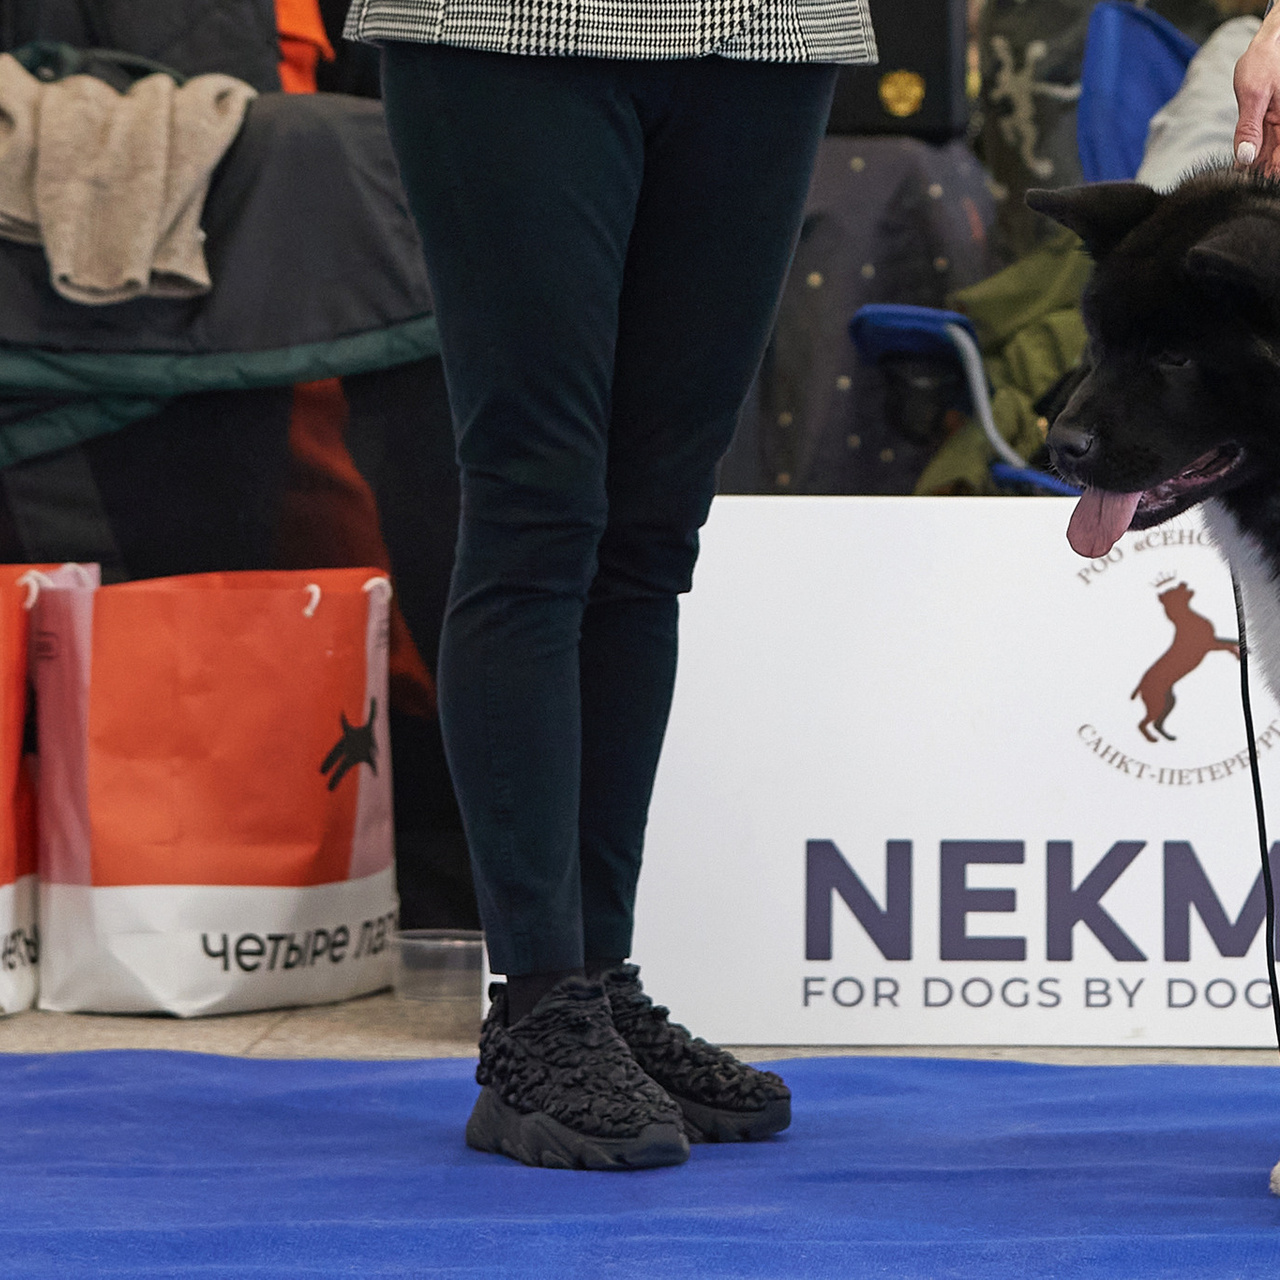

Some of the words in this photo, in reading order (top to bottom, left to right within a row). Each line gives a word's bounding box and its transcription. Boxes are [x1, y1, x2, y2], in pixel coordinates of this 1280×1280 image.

[803, 976, 899, 1008] FOR
[923, 976, 1062, 1008] DOGS
[1085, 977, 1145, 1008] BY
[1167, 977, 1272, 1009] DOG
